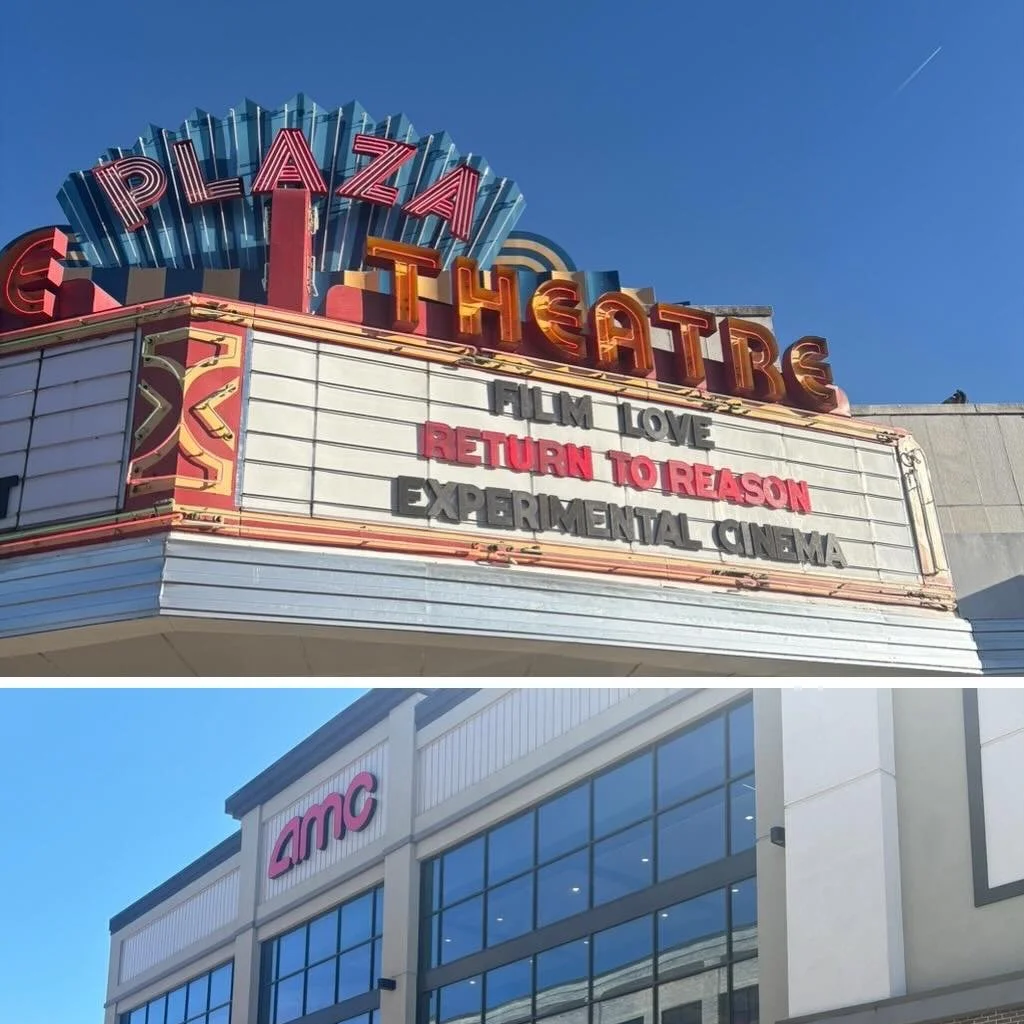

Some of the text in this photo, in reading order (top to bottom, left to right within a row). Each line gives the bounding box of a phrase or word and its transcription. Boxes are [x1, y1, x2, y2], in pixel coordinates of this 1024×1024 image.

[93, 128, 480, 242] PLAZA
[364, 236, 840, 413] THEATRE
[494, 380, 715, 450] FILM LOVE
[421, 420, 812, 514] RETURN TO REASON
[394, 475, 848, 568] EXPERIMENTAL CINEMA
